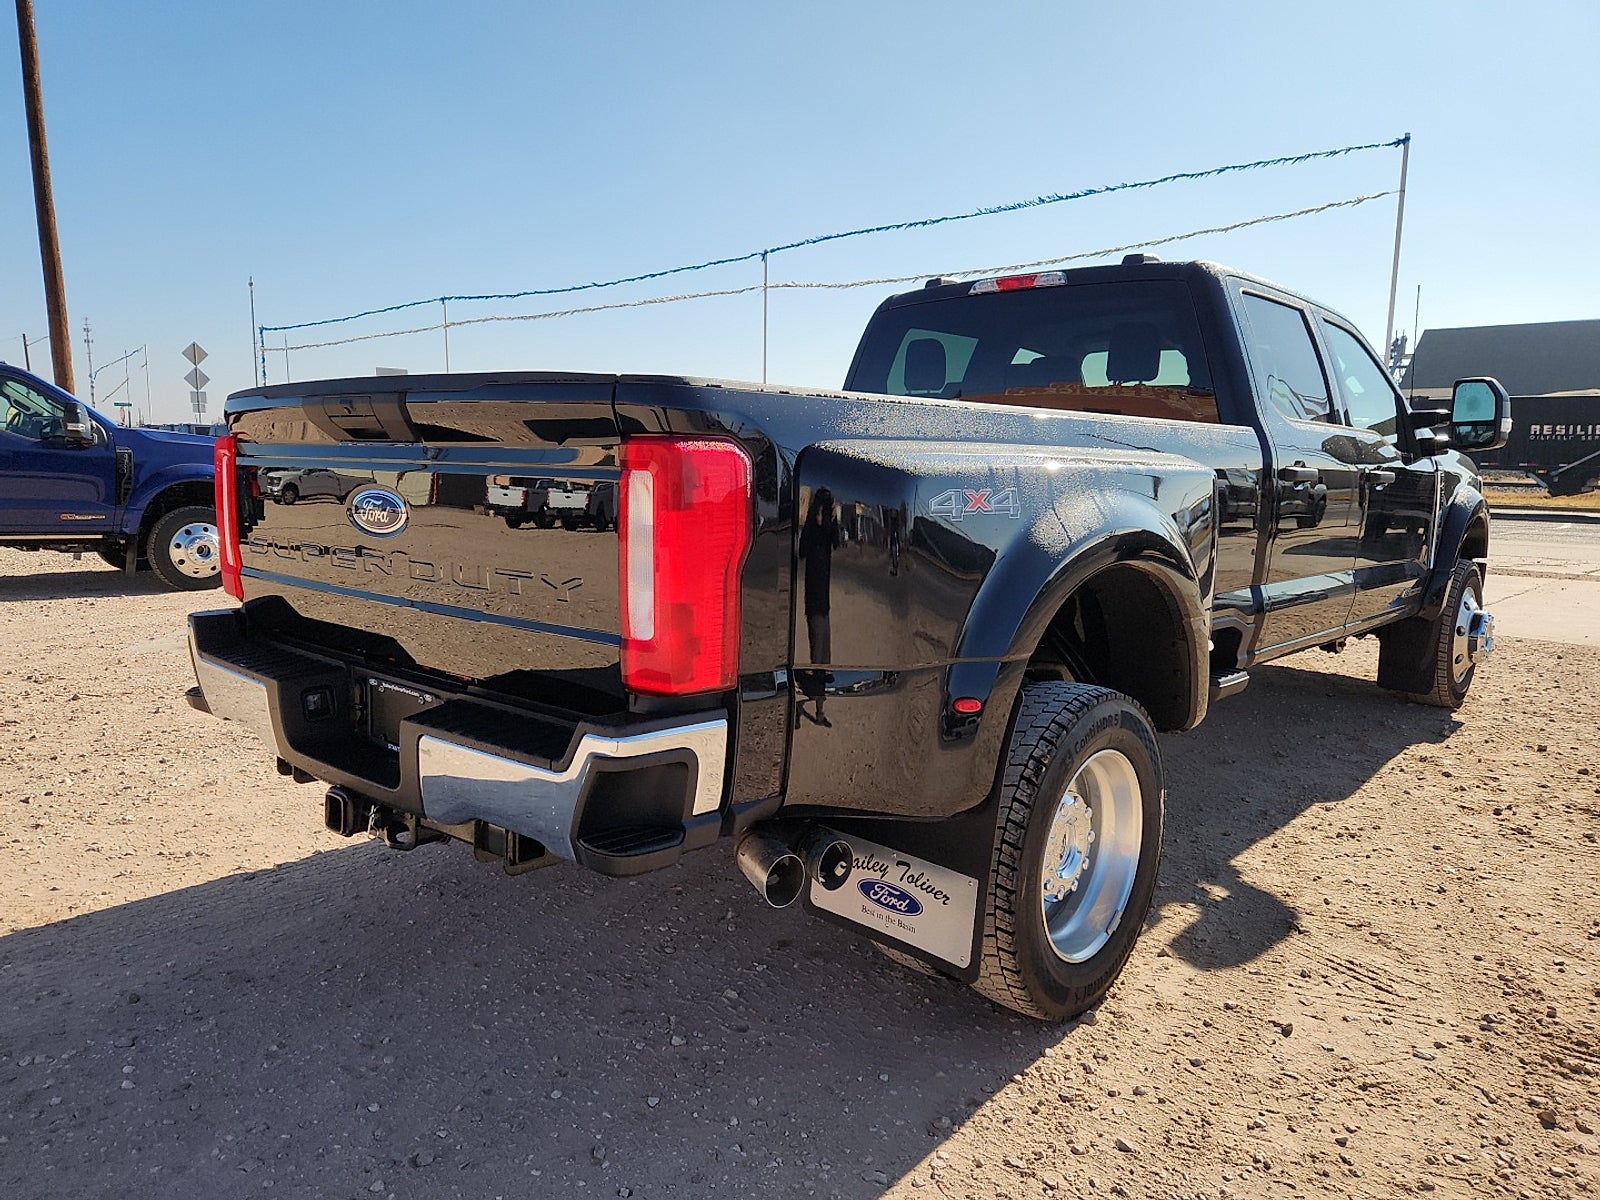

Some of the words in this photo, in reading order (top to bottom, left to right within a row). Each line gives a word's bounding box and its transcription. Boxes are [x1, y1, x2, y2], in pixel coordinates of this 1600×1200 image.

[361, 498, 389, 523] Ford
[248, 535, 394, 576] SUPER
[409, 559, 584, 602] DUTY
[853, 854, 889, 880] ailey
[896, 860, 951, 903] Toliver
[870, 883, 909, 911] Ford
[861, 904, 876, 917] Best
[876, 912, 884, 921] in
[885, 914, 896, 925] the
[897, 918, 916, 934] Basin
